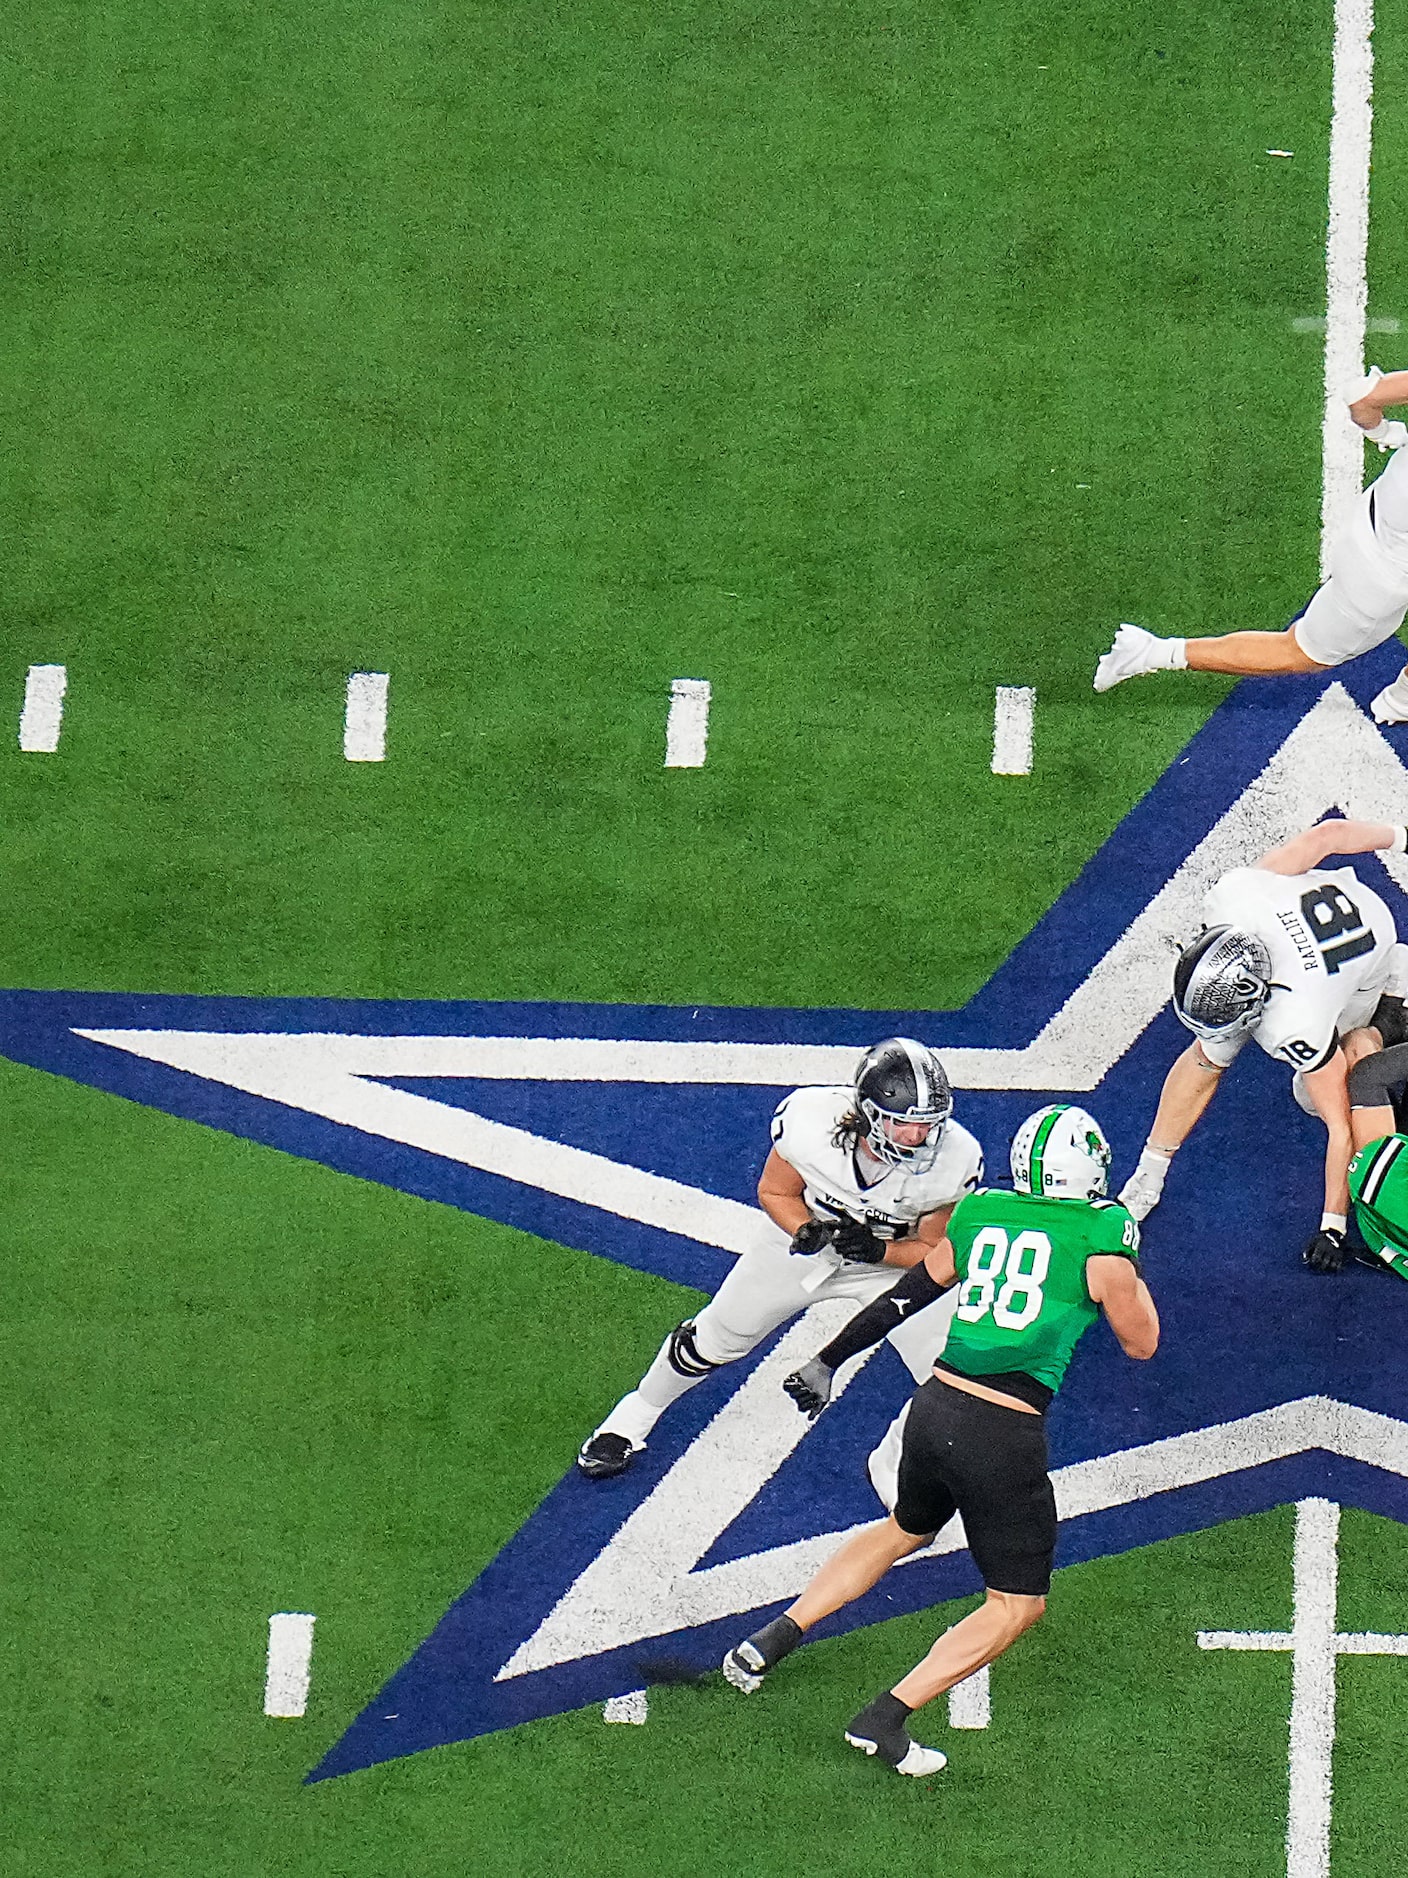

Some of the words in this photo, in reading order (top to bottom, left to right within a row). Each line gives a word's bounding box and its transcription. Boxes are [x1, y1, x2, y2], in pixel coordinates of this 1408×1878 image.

[1276, 910, 1319, 972] RATCLIFF
[1299, 883, 1378, 977] 18
[1278, 1039, 1320, 1067] 18
[956, 1226, 1053, 1331] 88
